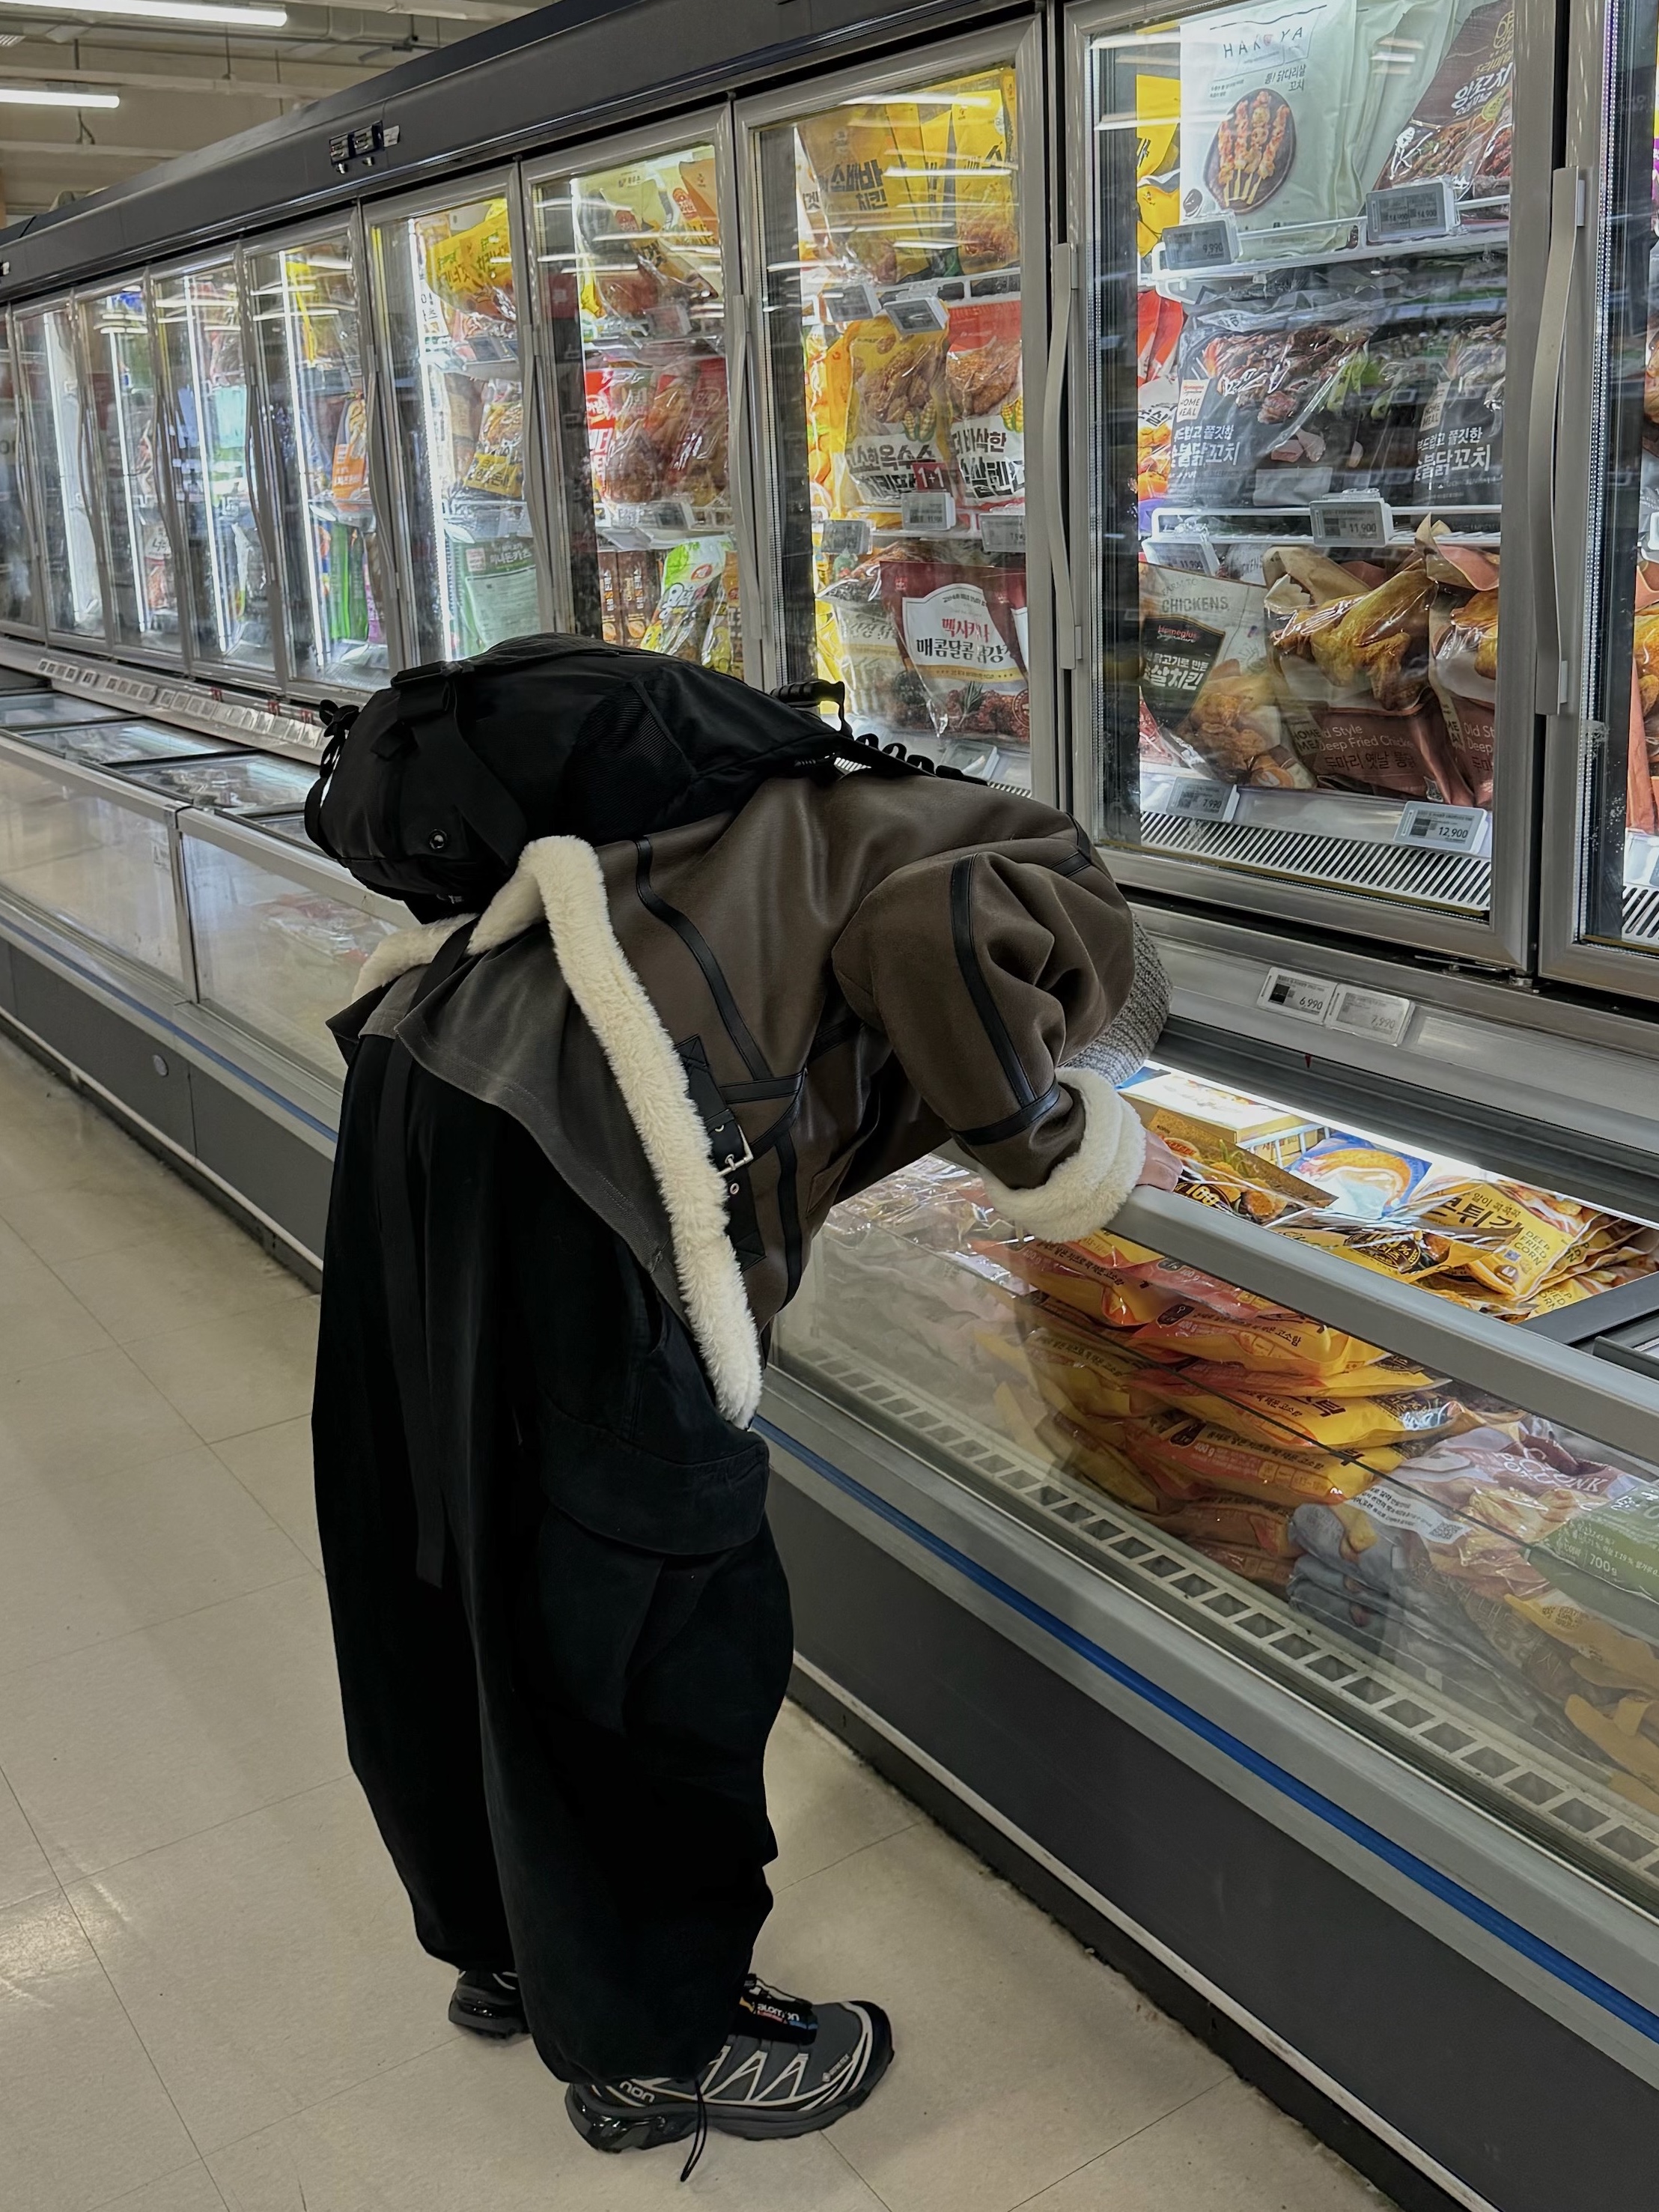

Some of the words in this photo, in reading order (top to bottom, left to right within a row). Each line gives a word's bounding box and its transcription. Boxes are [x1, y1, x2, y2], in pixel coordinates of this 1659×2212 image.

[1202, 243, 1223, 255] 9,990
[1180, 398, 1200, 407] OME
[1174, 426, 1202, 442] 드럽고
[918, 467, 944, 488] 1+1
[1162, 597, 1229, 613] CHICKENS
[916, 637, 974, 661] 매콤달콤
[1154, 653, 1190, 669] 닭고기로
[1333, 724, 1363, 738] Style
[1464, 722, 1480, 738] Old
[1482, 725, 1495, 738] St
[1348, 735, 1379, 748] Fried
[1325, 755, 1364, 771] 두마리
[1438, 826, 1469, 839] 12,900
[1276, 997, 1302, 1011] 6,990
[1369, 1015, 1397, 1030] 7,990
[1519, 1236, 1547, 1260] FRIED
[1525, 1230, 1550, 1251] DEEP
[1514, 1242, 1544, 1266] CORN
[1274, 1328, 1302, 1347] 고소함
